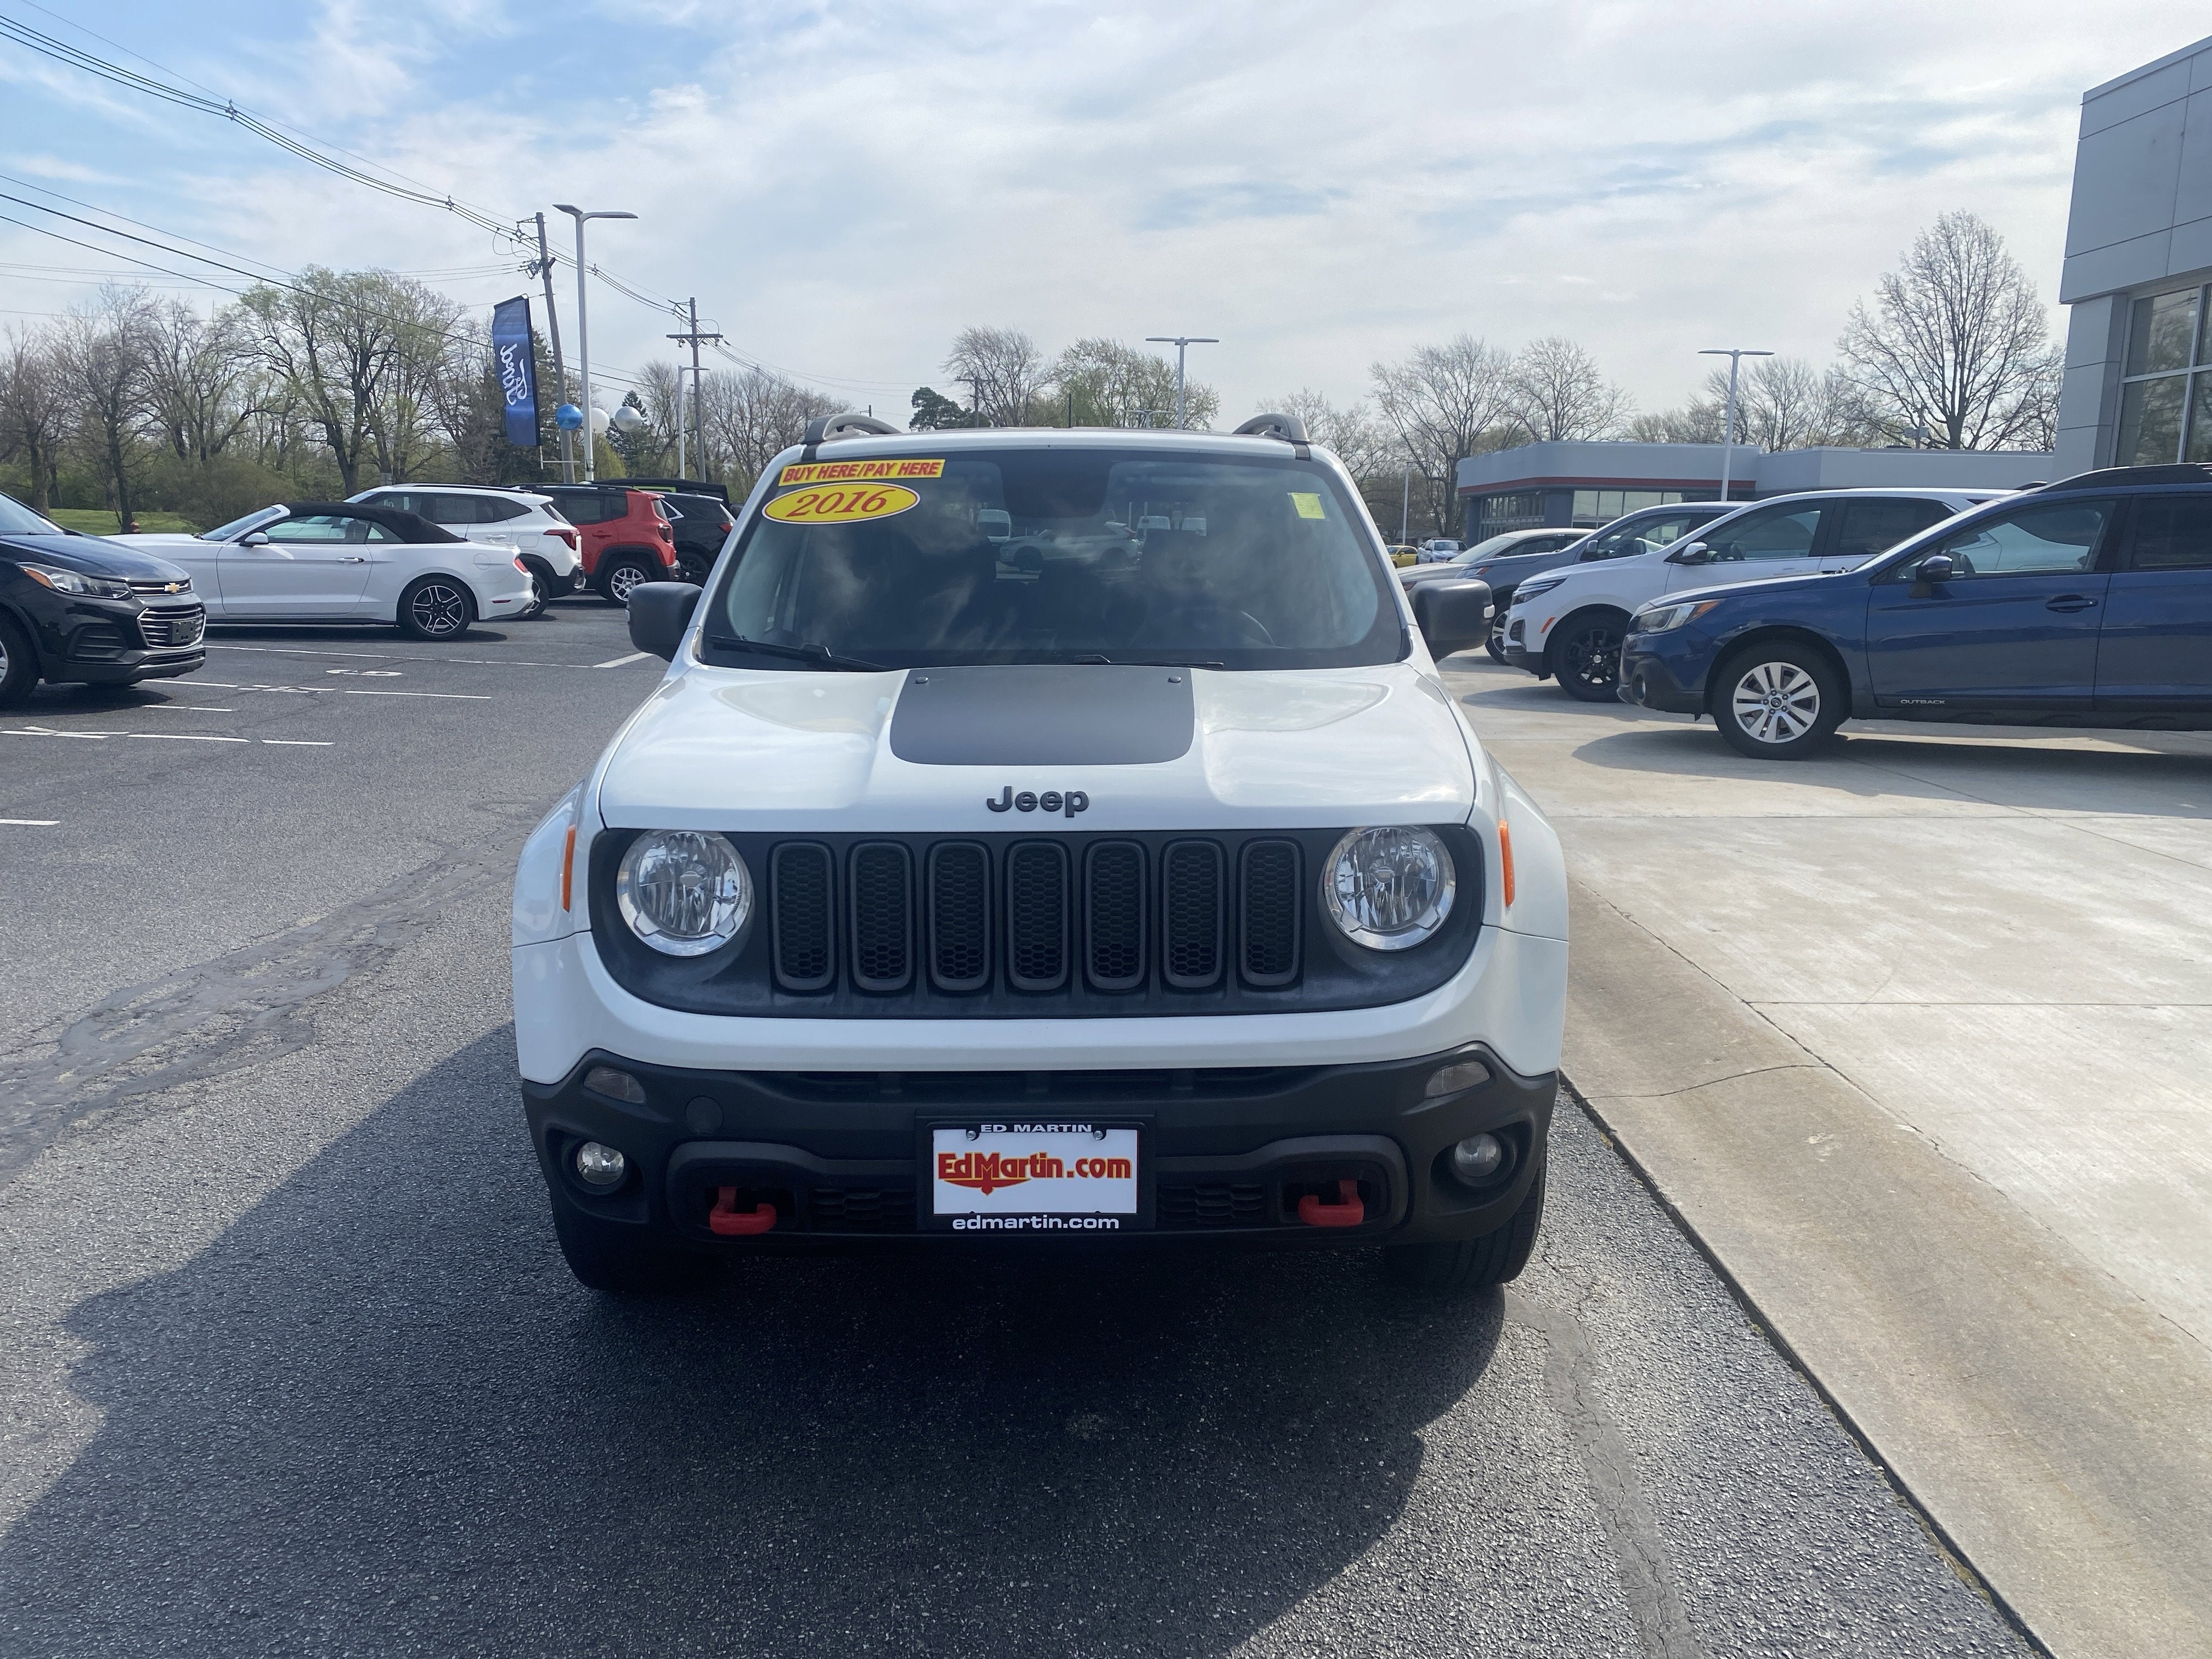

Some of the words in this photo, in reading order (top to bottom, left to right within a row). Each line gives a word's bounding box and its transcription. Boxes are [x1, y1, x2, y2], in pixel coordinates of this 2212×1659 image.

[783, 467, 816, 482] BUY
[817, 463, 894, 479] HERE/PAY
[897, 462, 940, 475] HERE
[785, 489, 896, 517] 2016
[986, 786, 1089, 818] Jeep
[980, 1124, 1007, 1133] ED
[1013, 1124, 1092, 1133] MARTIN
[938, 1152, 1132, 1195] EdMartin.com
[952, 1215, 1119, 1229] edmartin.com
